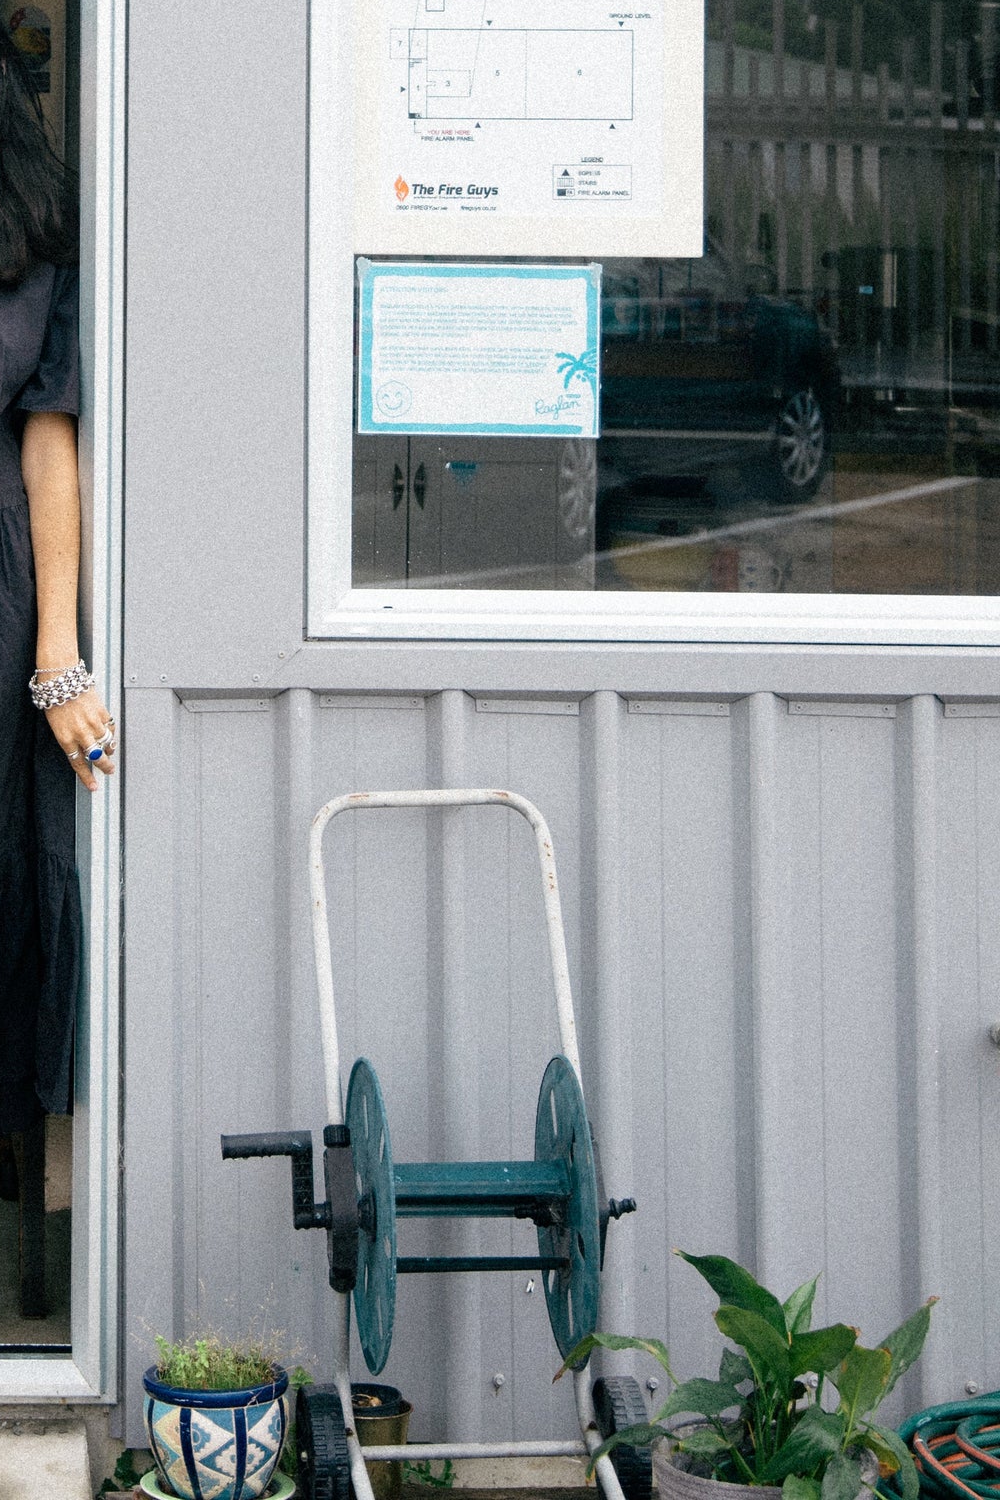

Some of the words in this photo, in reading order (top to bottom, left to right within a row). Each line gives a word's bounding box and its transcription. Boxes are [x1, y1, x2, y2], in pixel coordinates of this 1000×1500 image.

[412, 183, 435, 195] The
[438, 183, 463, 195] Fire
[467, 183, 499, 199] Guys
[534, 394, 581, 420] Raglan
